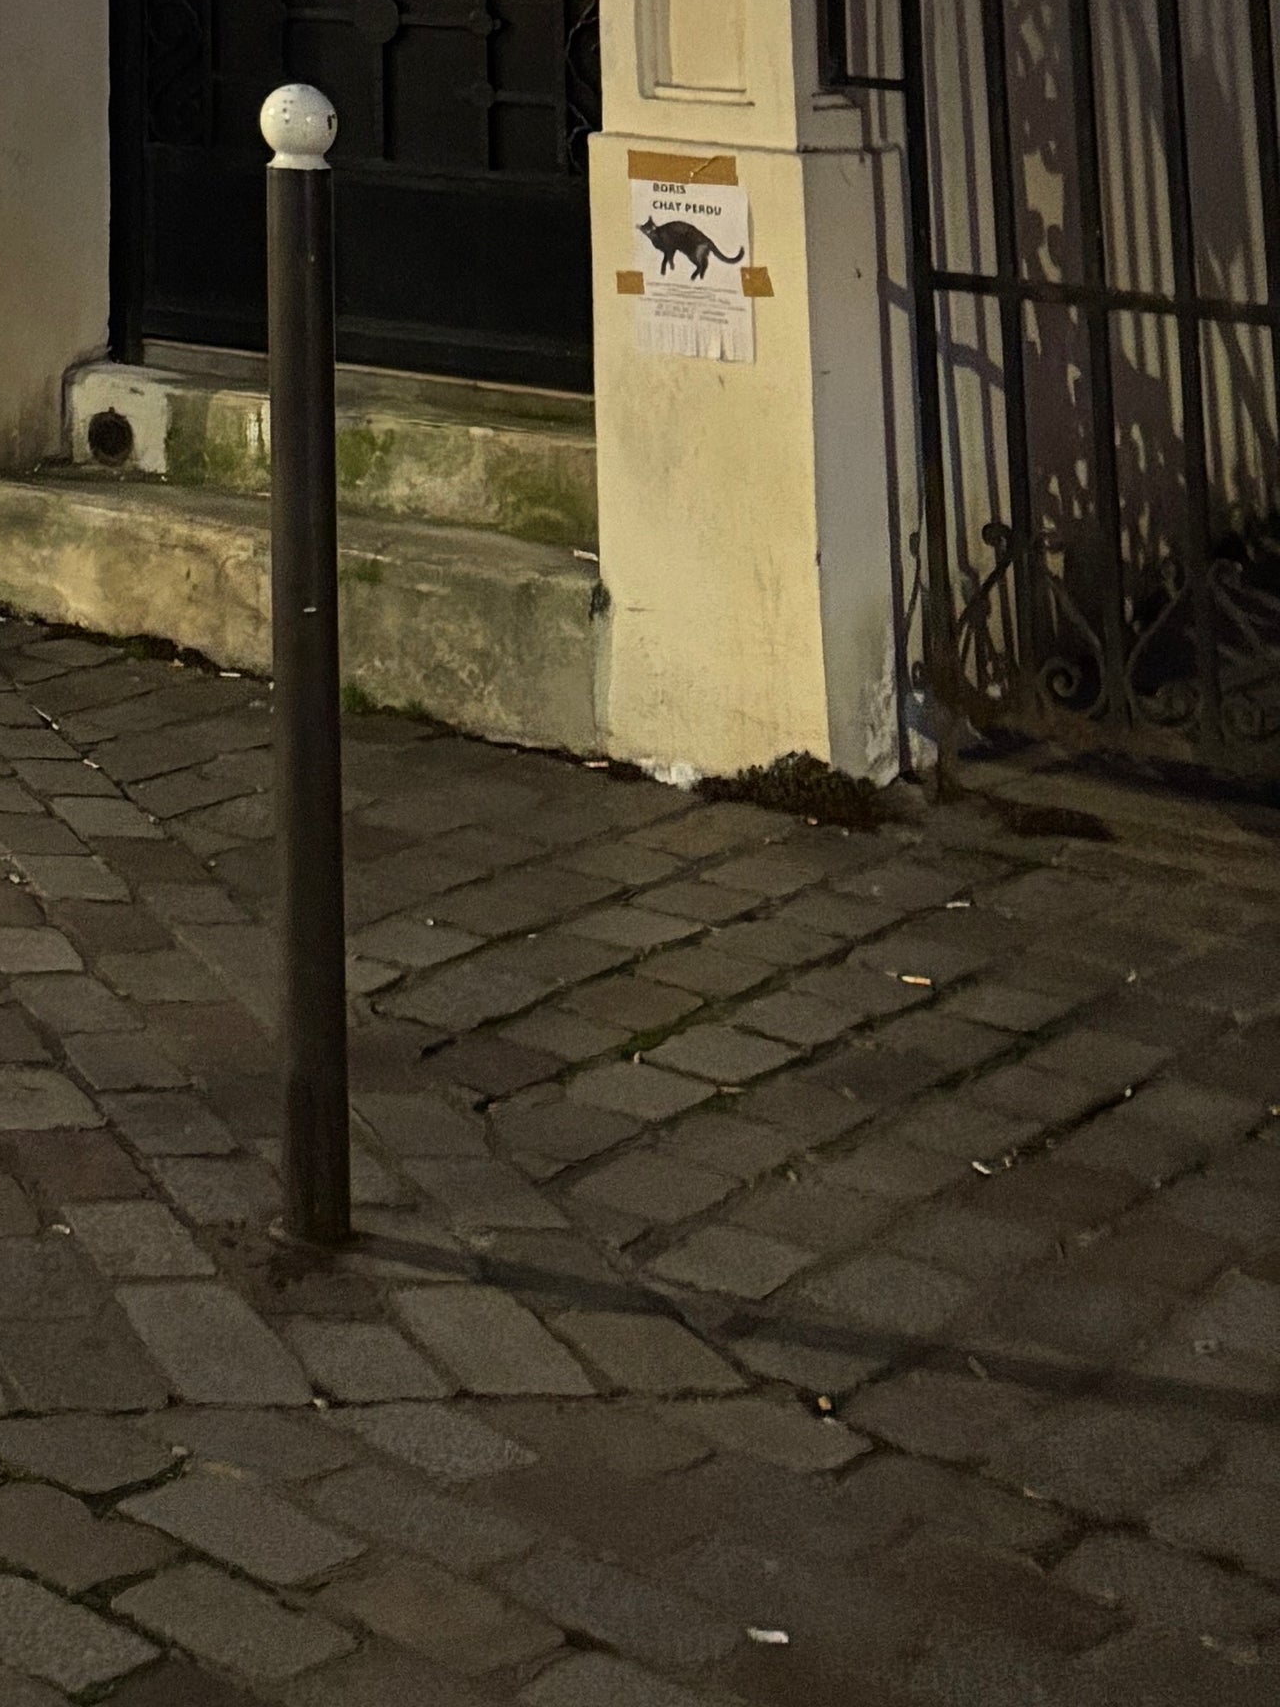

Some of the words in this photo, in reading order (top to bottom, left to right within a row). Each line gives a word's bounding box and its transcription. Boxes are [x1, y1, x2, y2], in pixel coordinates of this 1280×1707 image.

[652, 183, 686, 194] BORIS
[652, 200, 682, 211] CHAT
[685, 203, 722, 215] PERDU
